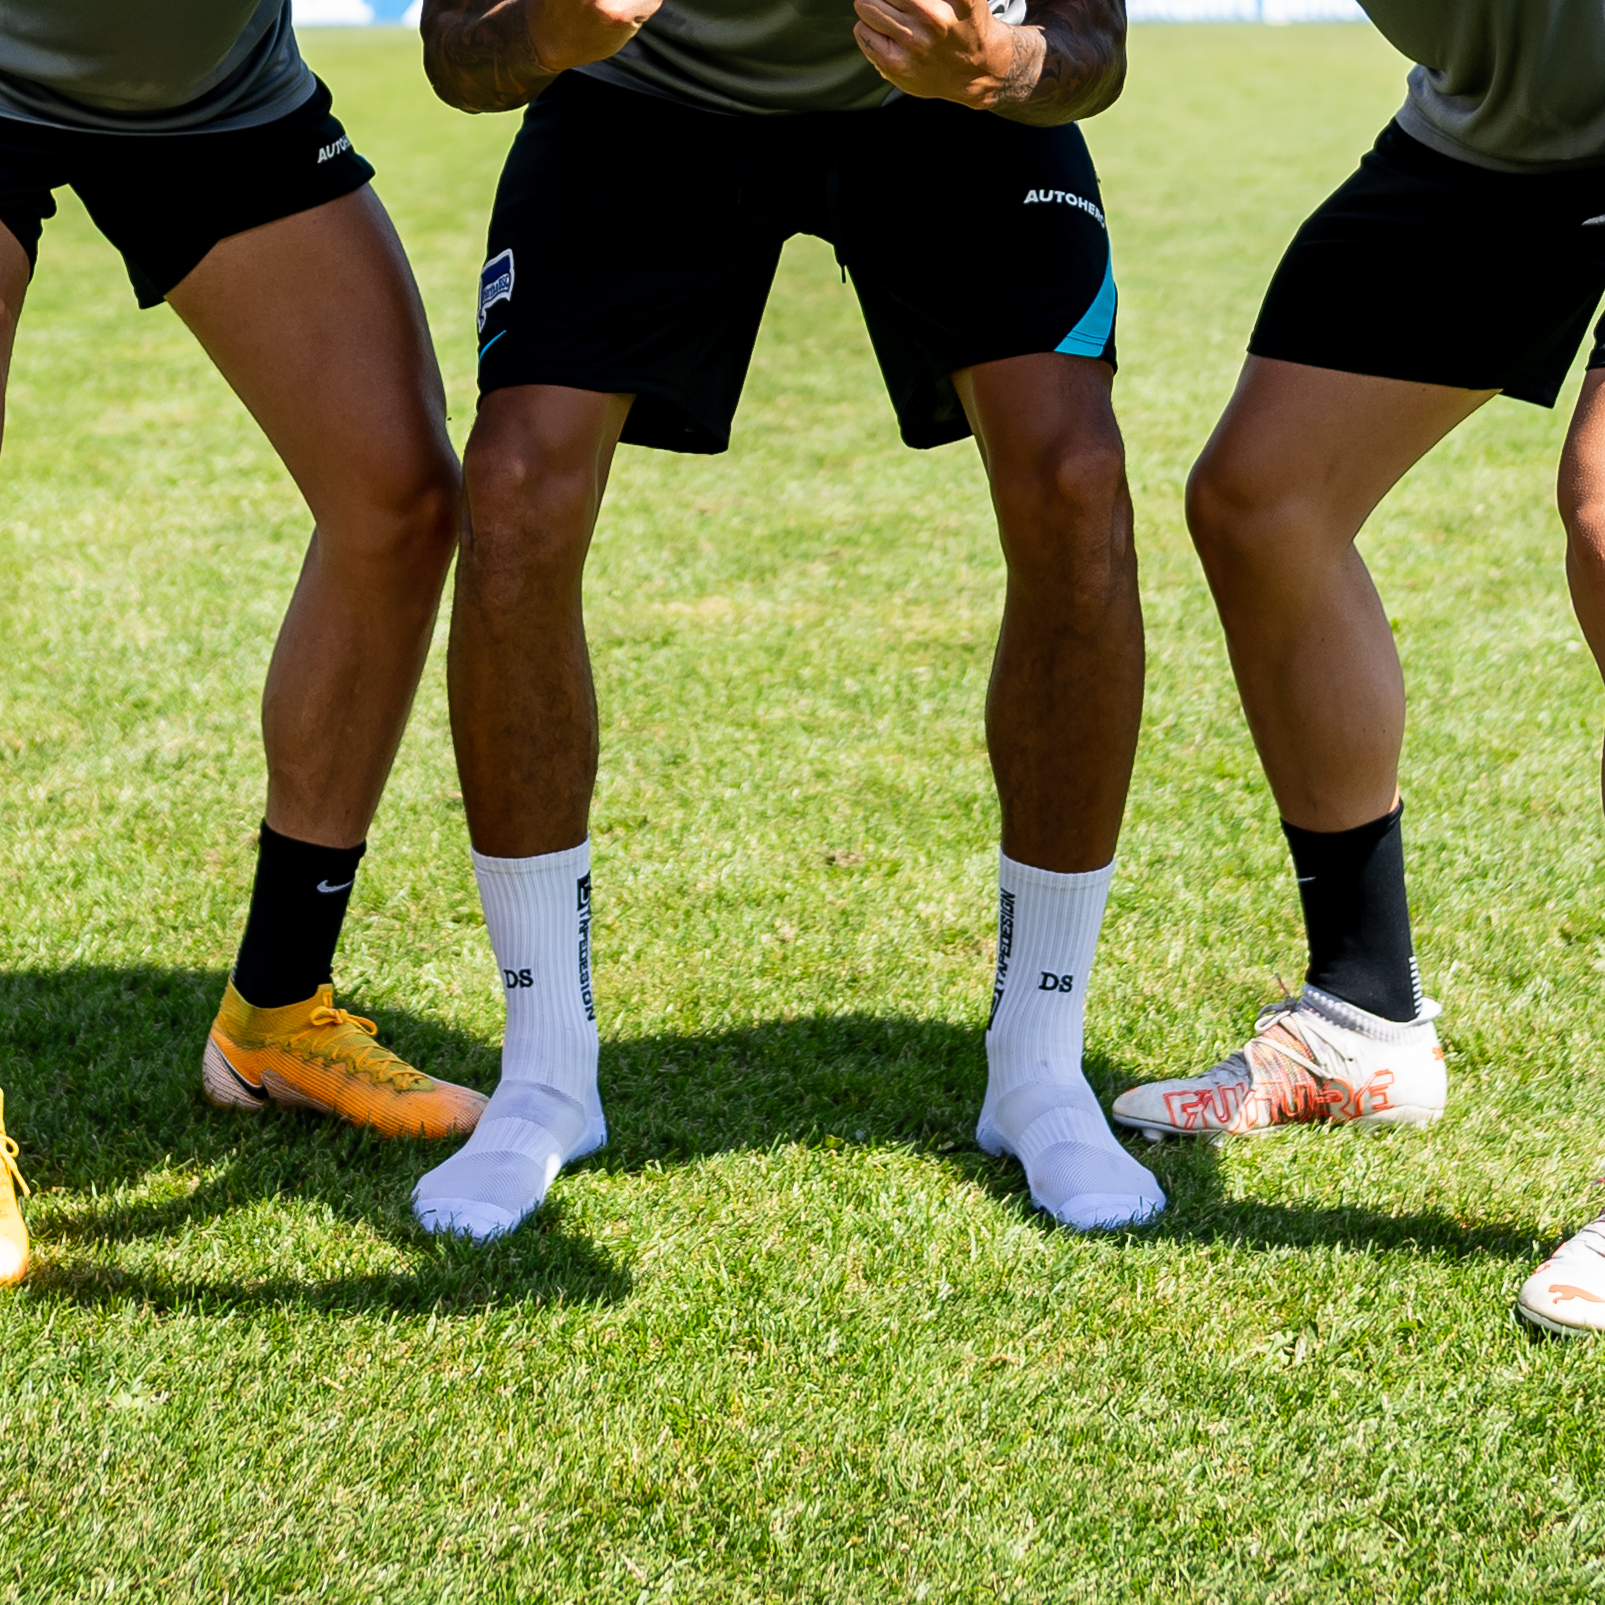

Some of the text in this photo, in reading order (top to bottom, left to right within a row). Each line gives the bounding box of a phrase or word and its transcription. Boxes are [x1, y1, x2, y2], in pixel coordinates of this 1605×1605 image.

[995, 887, 1016, 989] TAPEDESIGN
[503, 968, 534, 989] DS
[1038, 971, 1074, 993] DS
[1162, 1069, 1395, 1134] FUTURE
